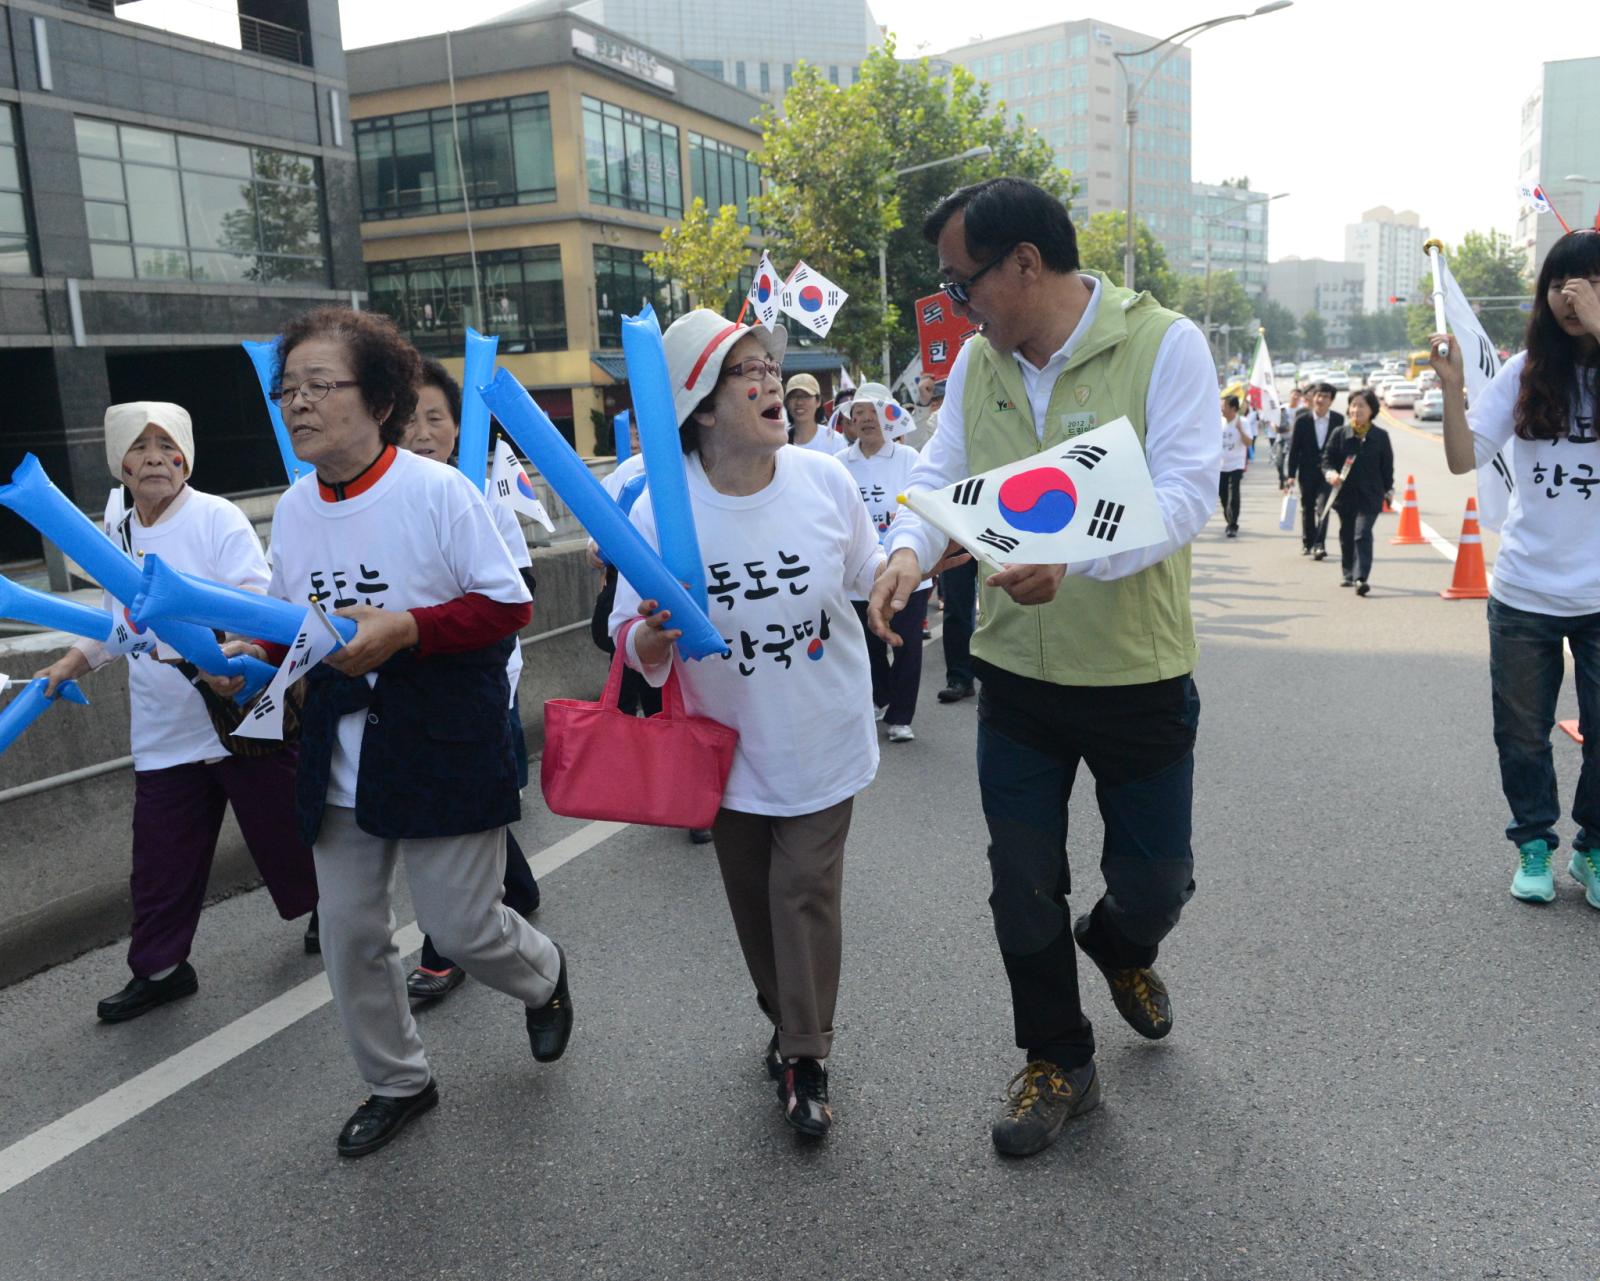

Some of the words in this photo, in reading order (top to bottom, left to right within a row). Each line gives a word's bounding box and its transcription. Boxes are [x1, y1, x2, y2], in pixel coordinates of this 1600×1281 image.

[1067, 420, 1085, 428] 2012
[1533, 462, 1600, 500] 한국
[707, 550, 811, 611] 독도는
[721, 609, 831, 676] 한국땅
